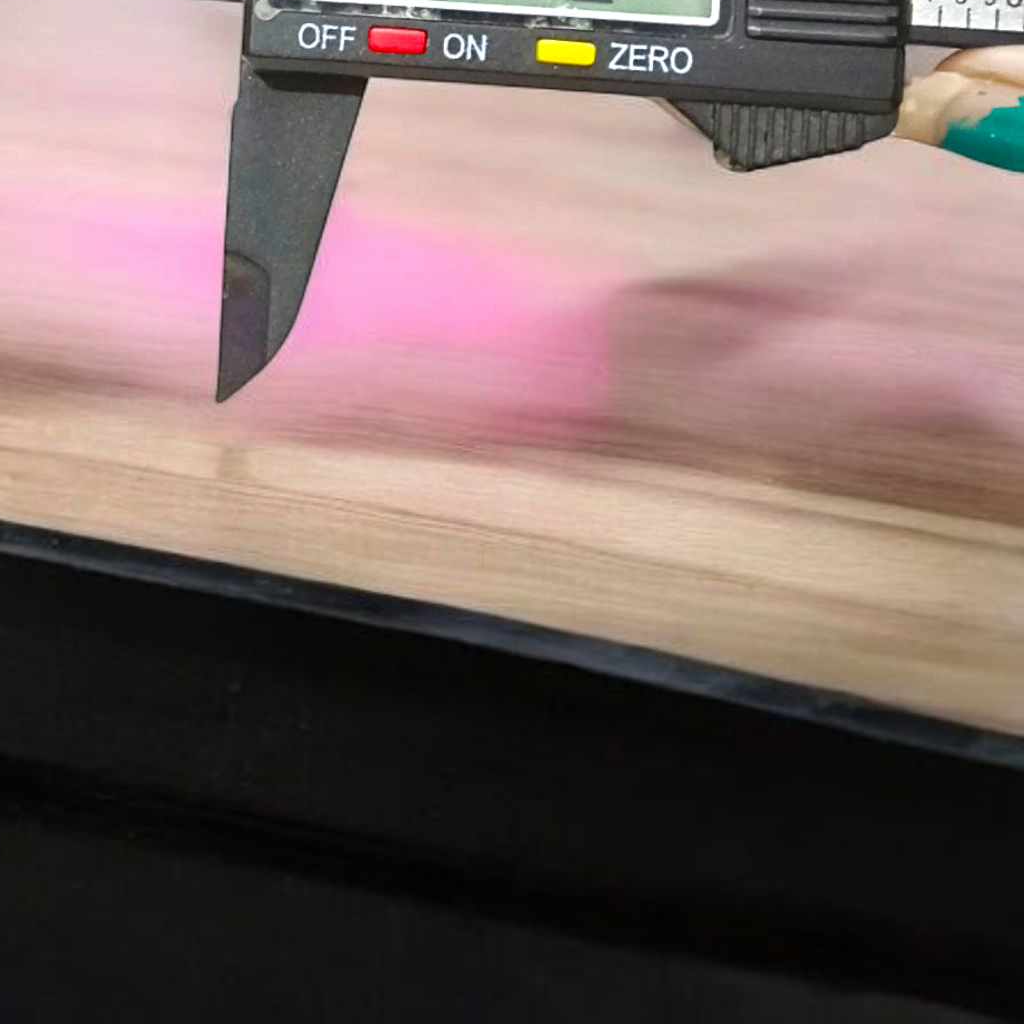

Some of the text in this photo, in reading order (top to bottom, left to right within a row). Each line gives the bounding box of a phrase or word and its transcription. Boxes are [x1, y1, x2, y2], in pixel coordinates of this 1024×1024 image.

[297, 22, 357, 52] OFF
[442, 32, 488, 62] ON
[608, 42, 694, 75] ZERO
